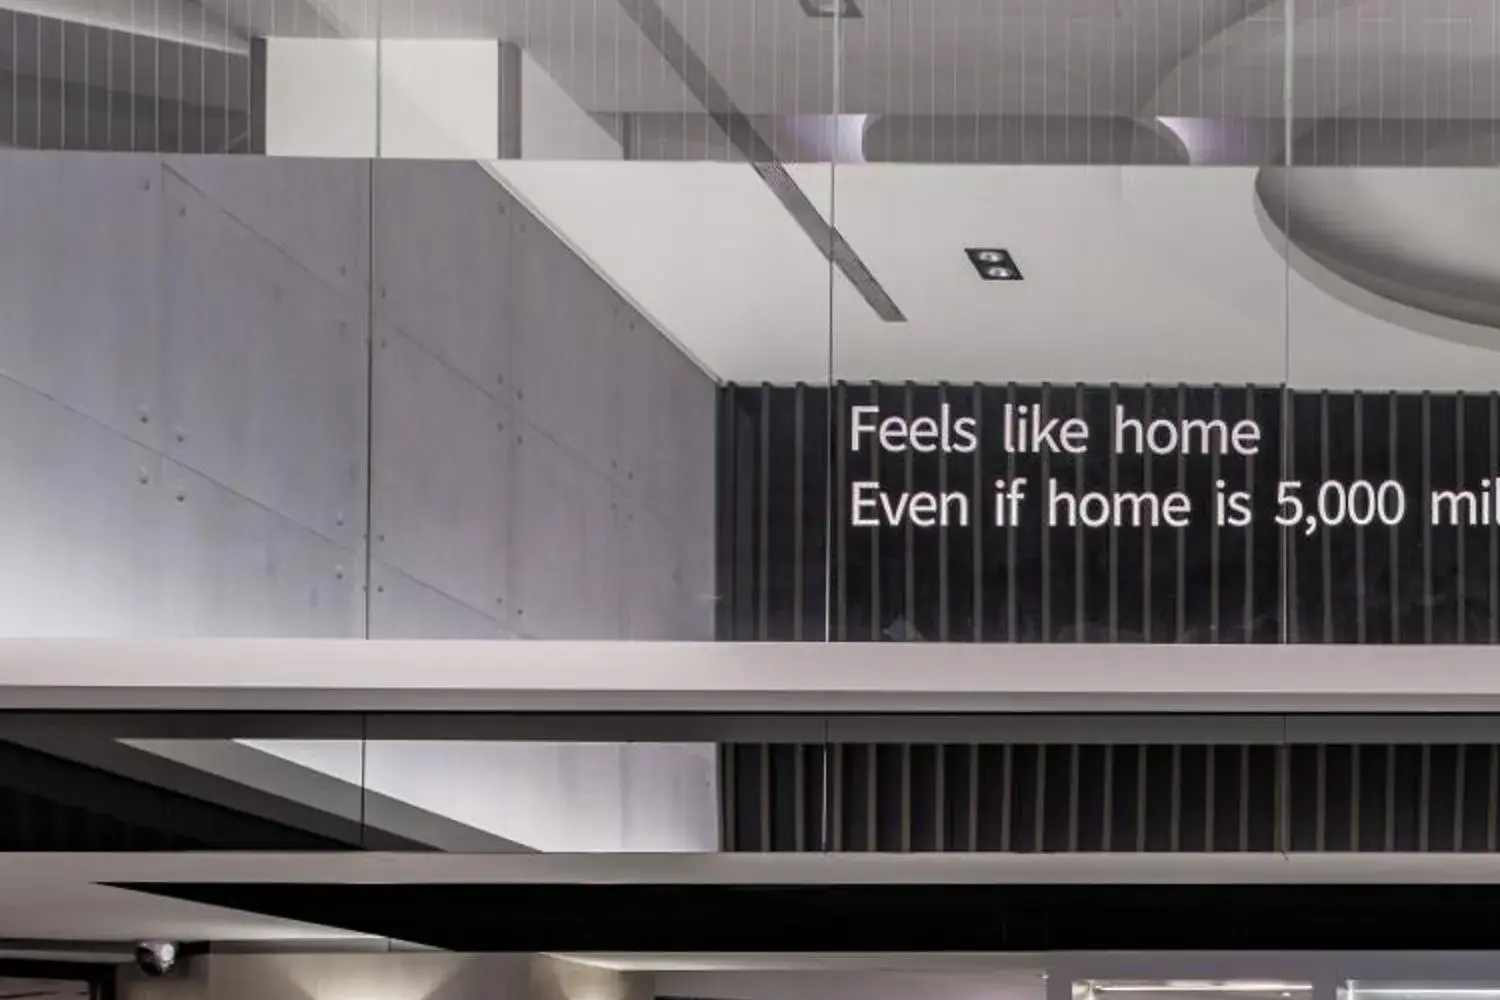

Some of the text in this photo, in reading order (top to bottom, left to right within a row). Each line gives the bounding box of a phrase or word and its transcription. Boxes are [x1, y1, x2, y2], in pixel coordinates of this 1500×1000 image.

[851, 402, 1262, 455] Feels like home
[851, 481, 968, 527] Even
[994, 477, 1027, 527] if
[1048, 478, 1191, 527] home
[1215, 479, 1253, 527] is
[1275, 479, 1405, 536] 5,000
